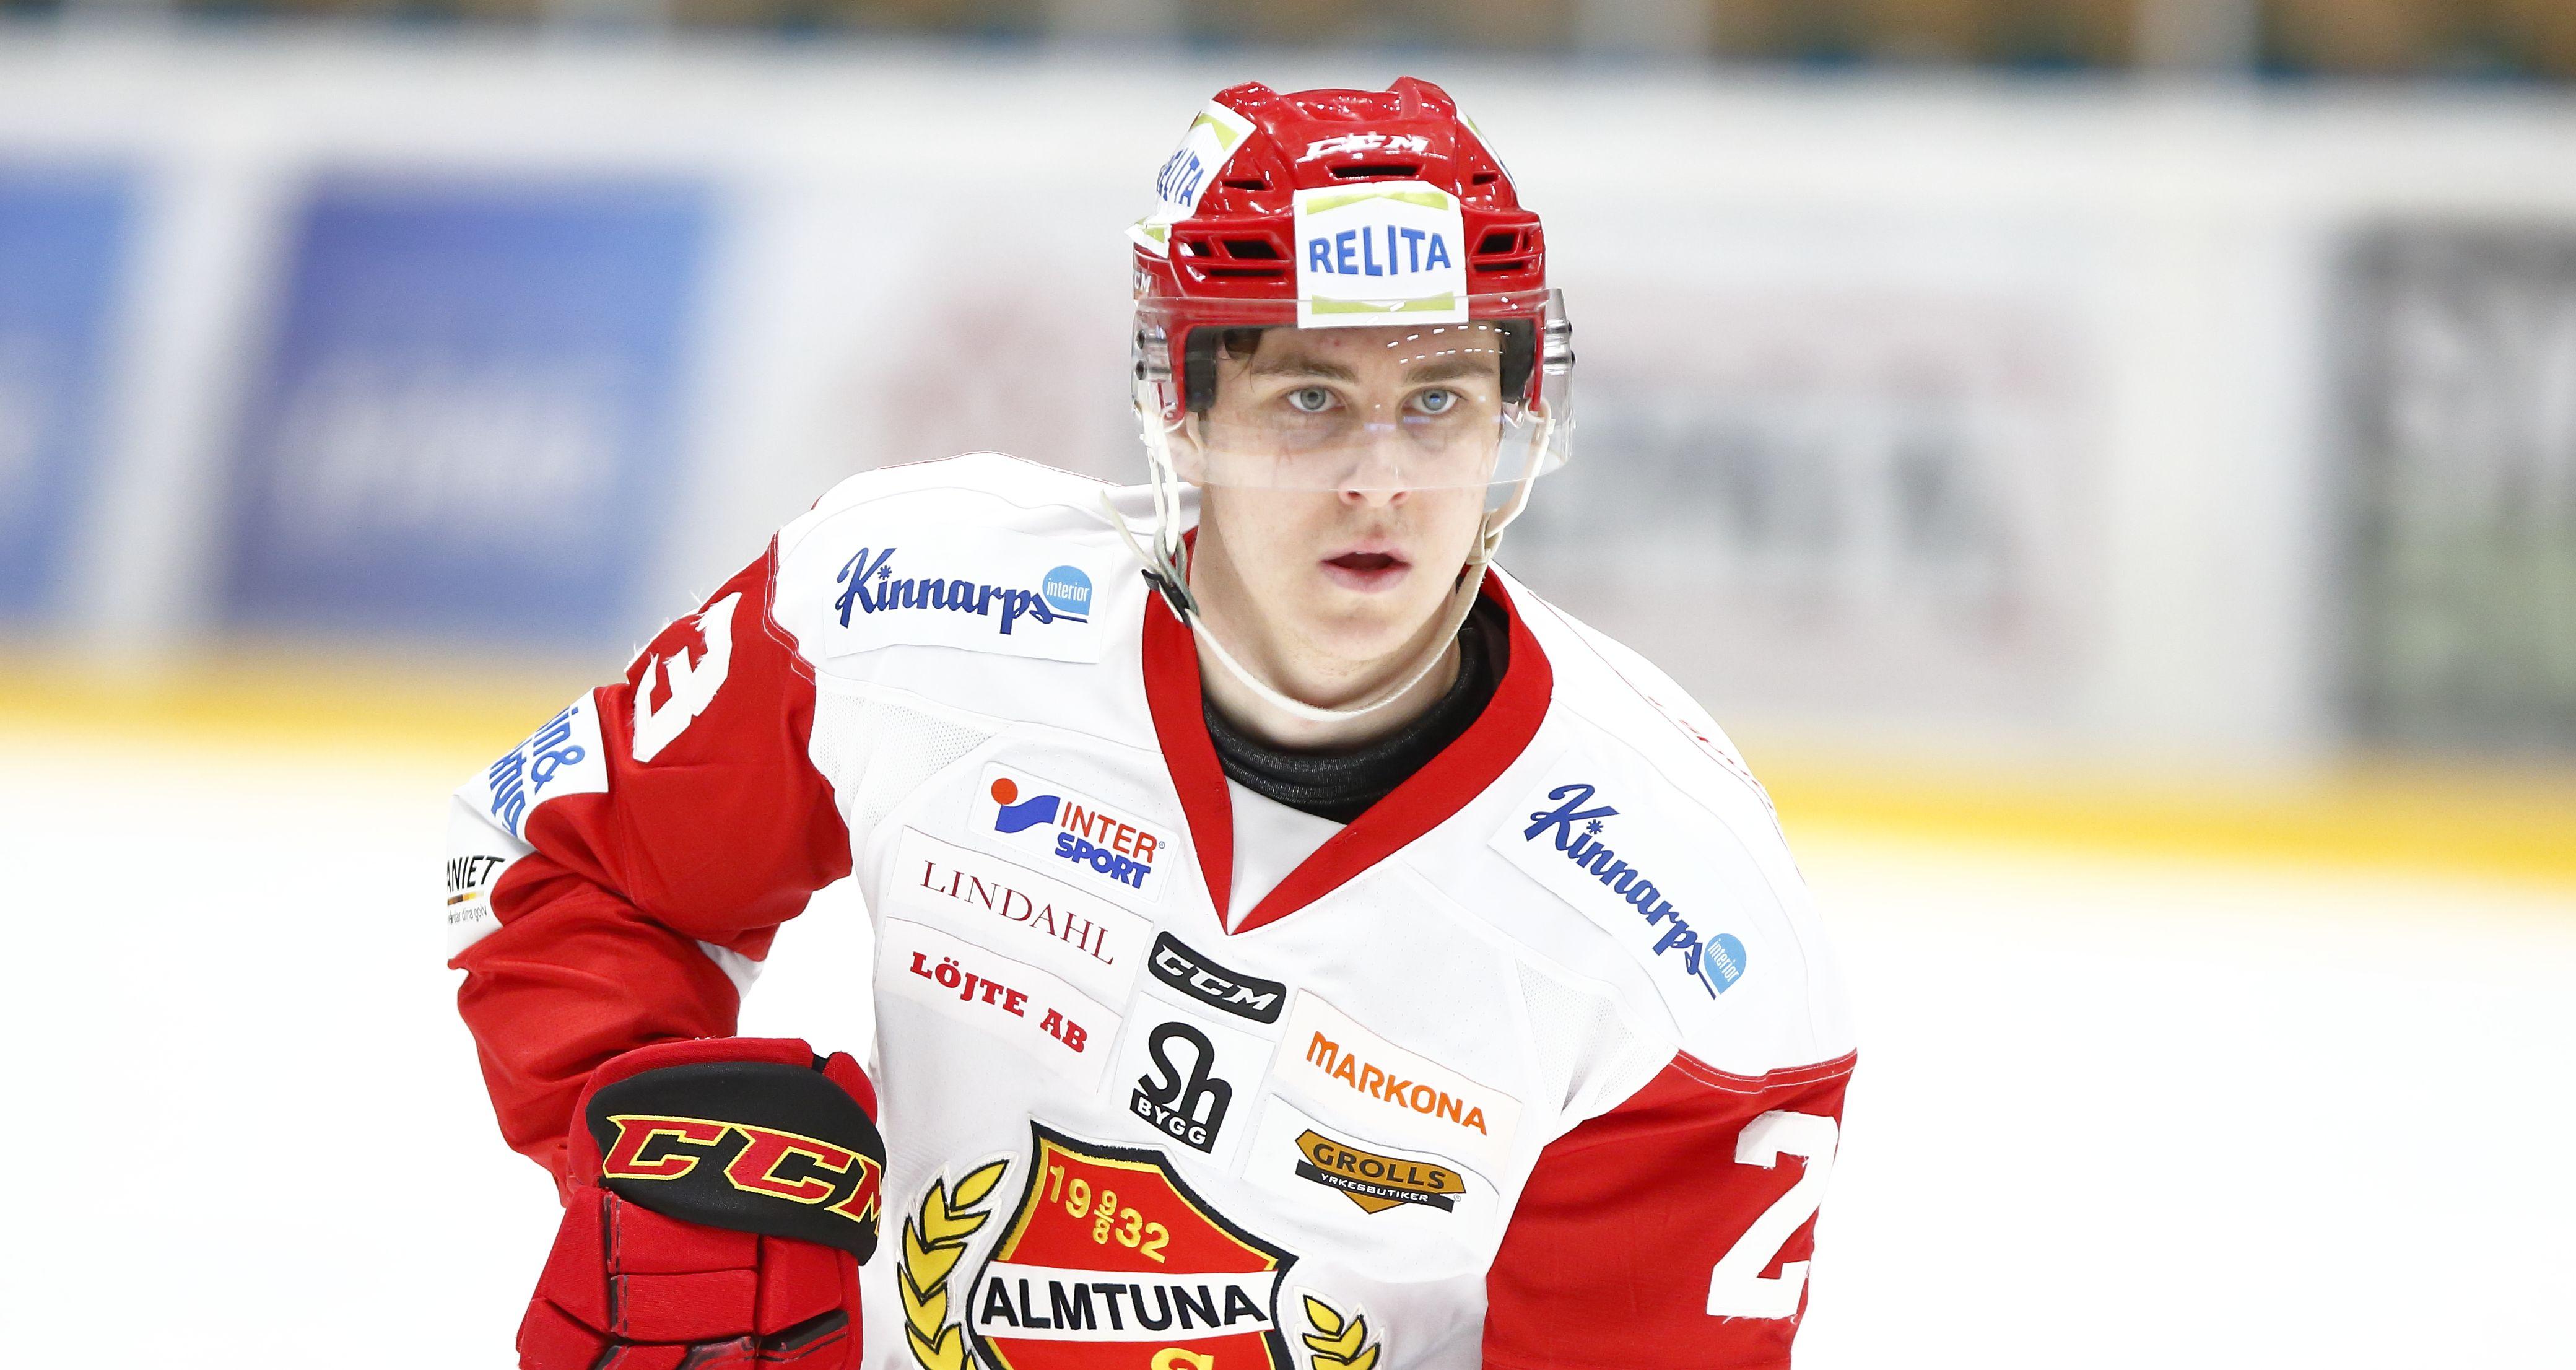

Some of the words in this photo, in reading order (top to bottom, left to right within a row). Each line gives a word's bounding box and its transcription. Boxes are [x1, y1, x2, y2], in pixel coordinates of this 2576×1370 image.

[1308, 225, 1451, 276] RELITA
[835, 548, 1088, 635] Kinnarps
[1046, 578, 1089, 602] interior
[531, 706, 585, 795] in&
[1055, 832, 1151, 889] SPORT
[1061, 801, 1157, 863] INTER
[920, 862, 1114, 966] LINDAHL
[1524, 784, 1717, 1000] Kinnarps
[1156, 945, 1279, 1012] CCM
[1707, 940, 1739, 982] interior
[910, 951, 1029, 1018] LÖJTE
[1040, 1008, 1089, 1054] AB
[1306, 1031, 1487, 1135] MARKONA
[1136, 1097, 1208, 1146] BYGG
[1313, 1143, 1447, 1189] GROLLS
[1321, 1173, 1429, 1202] YRKESBUTIKER
[1706, 1110, 1839, 1319] 2
[982, 1278, 1269, 1332] ALMTUNA
